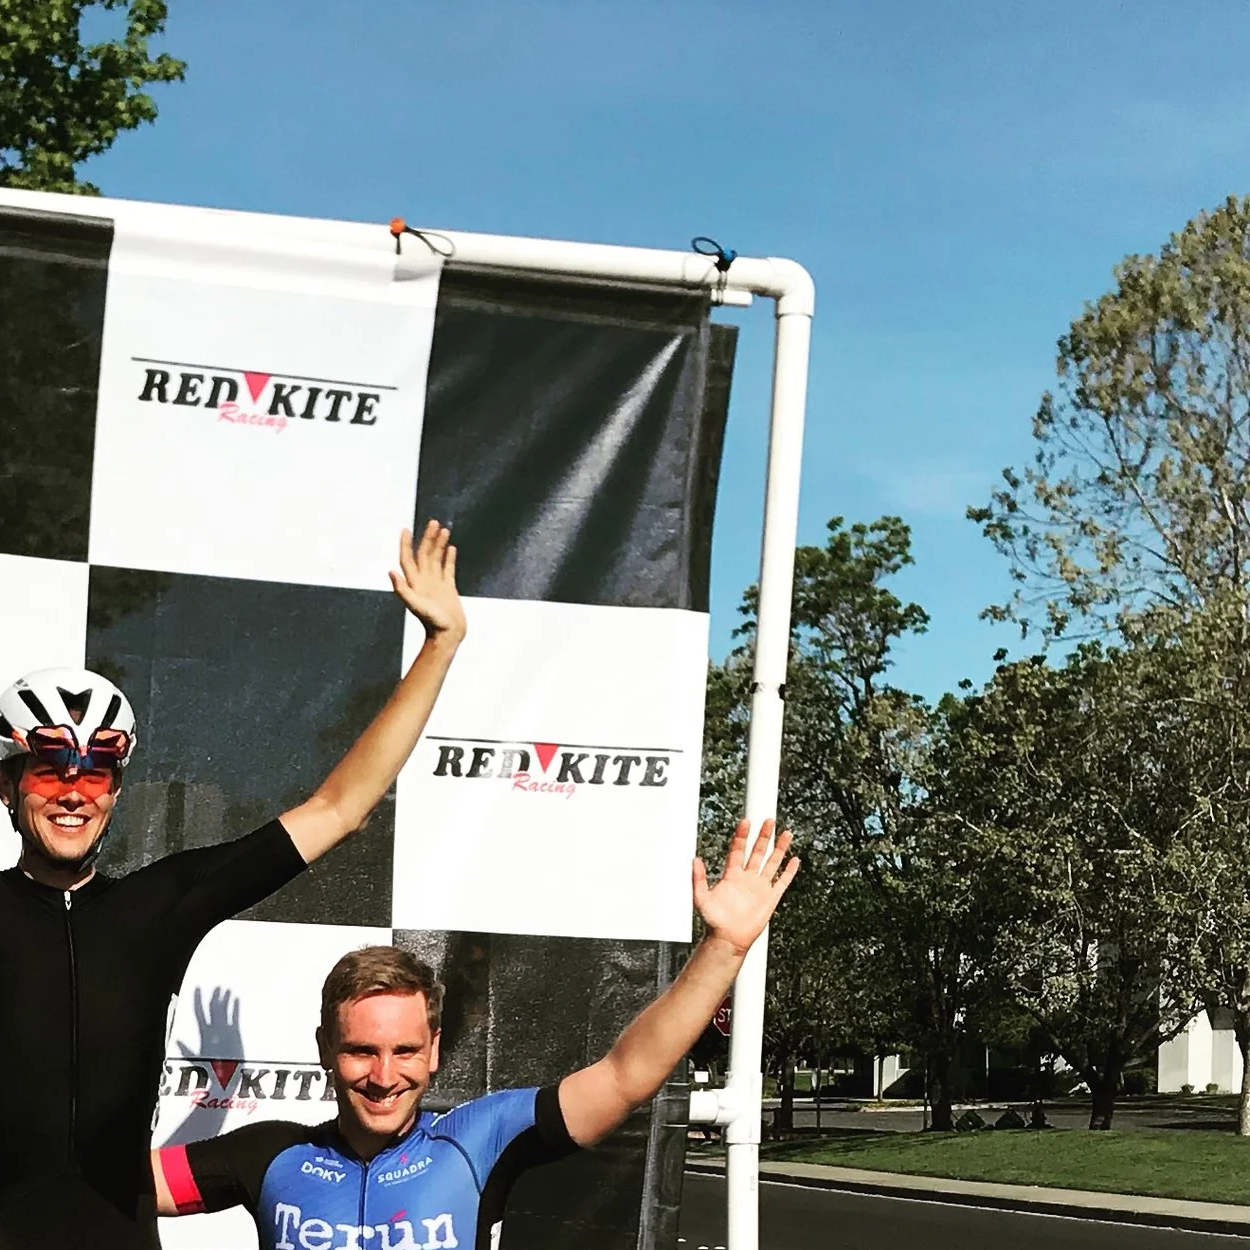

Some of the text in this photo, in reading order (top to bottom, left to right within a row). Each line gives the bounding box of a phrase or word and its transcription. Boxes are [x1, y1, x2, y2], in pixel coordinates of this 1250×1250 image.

[138, 369, 381, 426] RED KITE
[217, 401, 288, 433] Racing
[433, 746, 670, 787] RED KITE
[512, 771, 576, 799] Racing
[189, 1087, 258, 1115] Racing
[377, 1156, 433, 1184] SQUADRA
